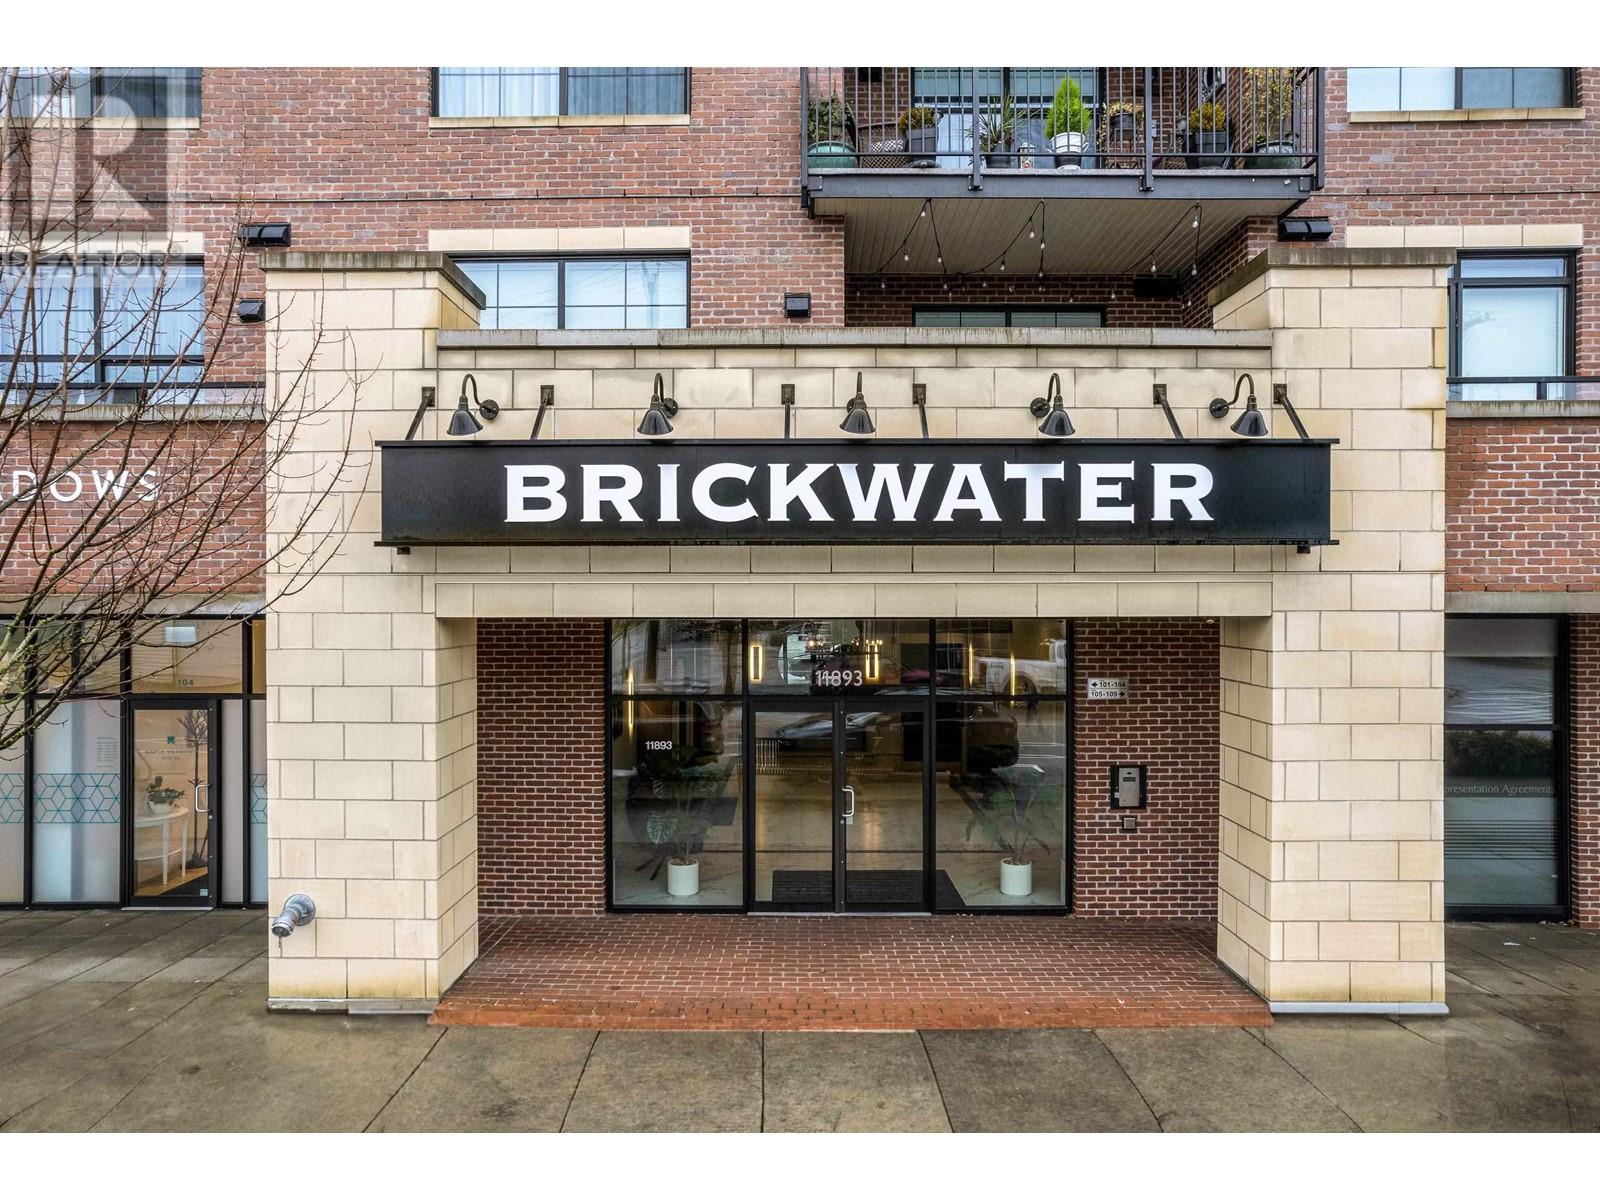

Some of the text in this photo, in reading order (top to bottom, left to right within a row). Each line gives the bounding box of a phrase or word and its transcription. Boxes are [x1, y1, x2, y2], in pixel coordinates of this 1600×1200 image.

[0, 470, 160, 502] DOWS
[504, 461, 1215, 523] BRICKWATER
[815, 670, 863, 687] 11893
[645, 740, 673, 750] 11893
